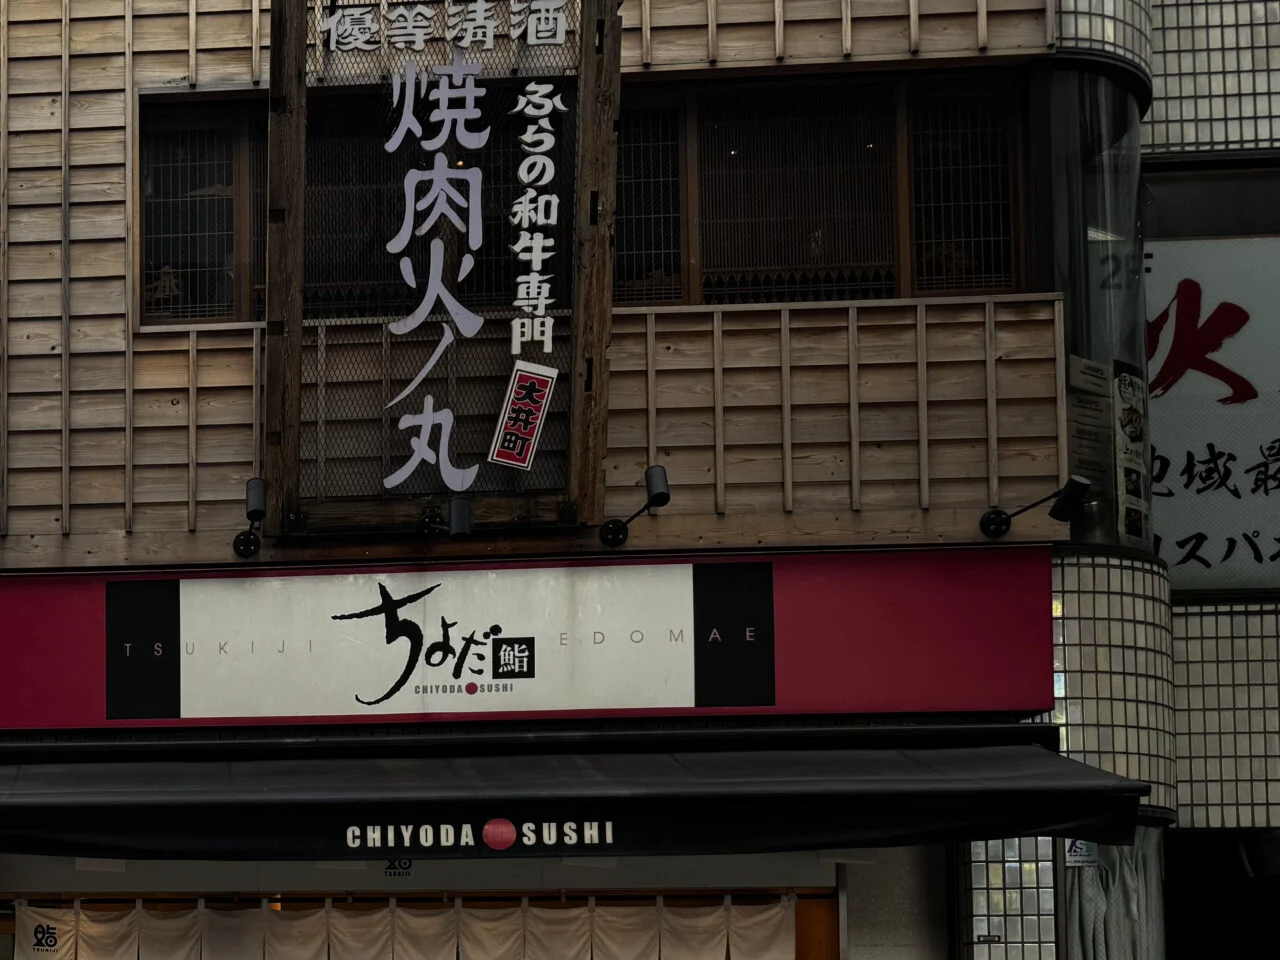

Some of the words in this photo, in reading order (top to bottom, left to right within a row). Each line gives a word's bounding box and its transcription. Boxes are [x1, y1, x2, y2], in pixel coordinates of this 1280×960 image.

[507, 81, 569, 356] ふらの和牛専門
[383, 53, 491, 492] 焼肉火ノ丸
[498, 379, 550, 460] 大井町
[123, 640, 313, 657] TSUKIJI
[558, 626, 756, 647] EDOMAE
[414, 684, 463, 695] CHIYODA
[479, 682, 514, 693] SUSHI
[344, 823, 476, 848] CHIYODA
[521, 821, 615, 846] SUSHI
